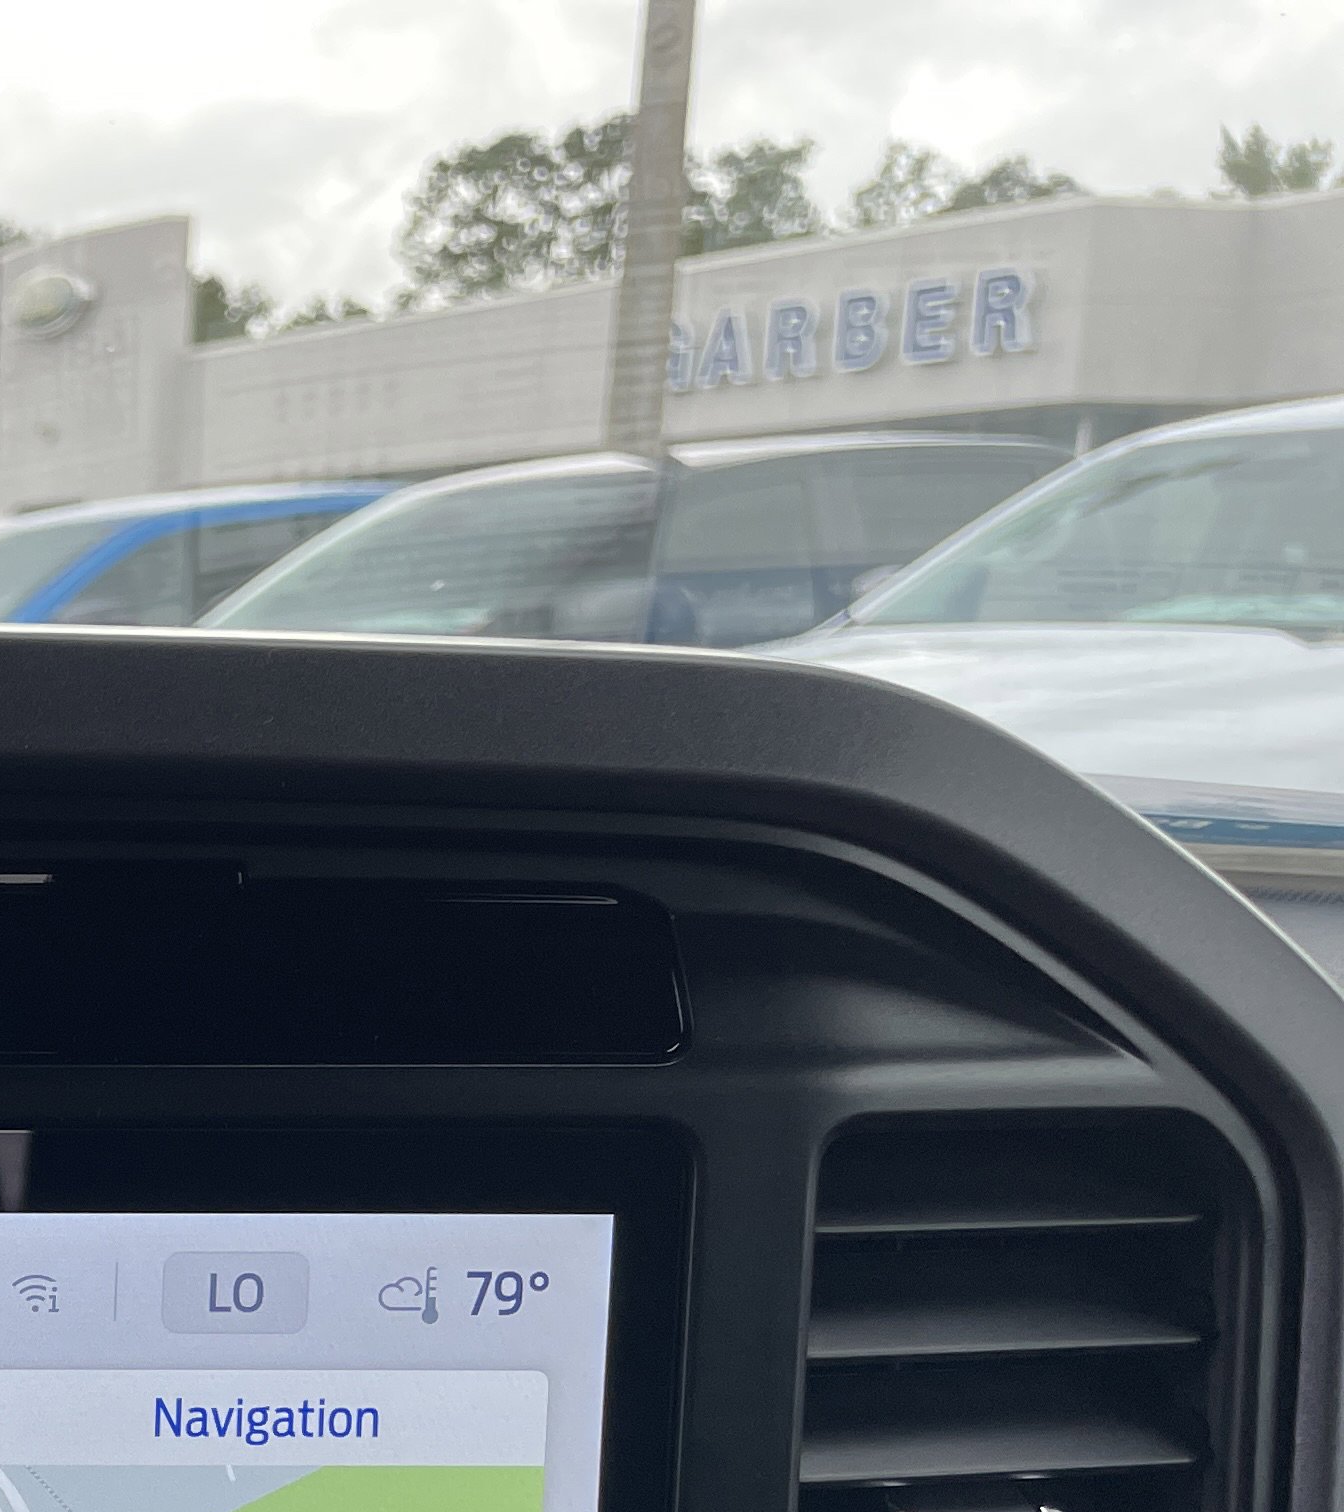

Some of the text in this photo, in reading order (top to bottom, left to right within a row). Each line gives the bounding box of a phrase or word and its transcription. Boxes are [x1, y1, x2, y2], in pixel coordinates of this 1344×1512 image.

[208, 1272, 264, 1313] LO
[466, 1270, 550, 1316] 79°
[154, 1397, 379, 1446] Navigation
